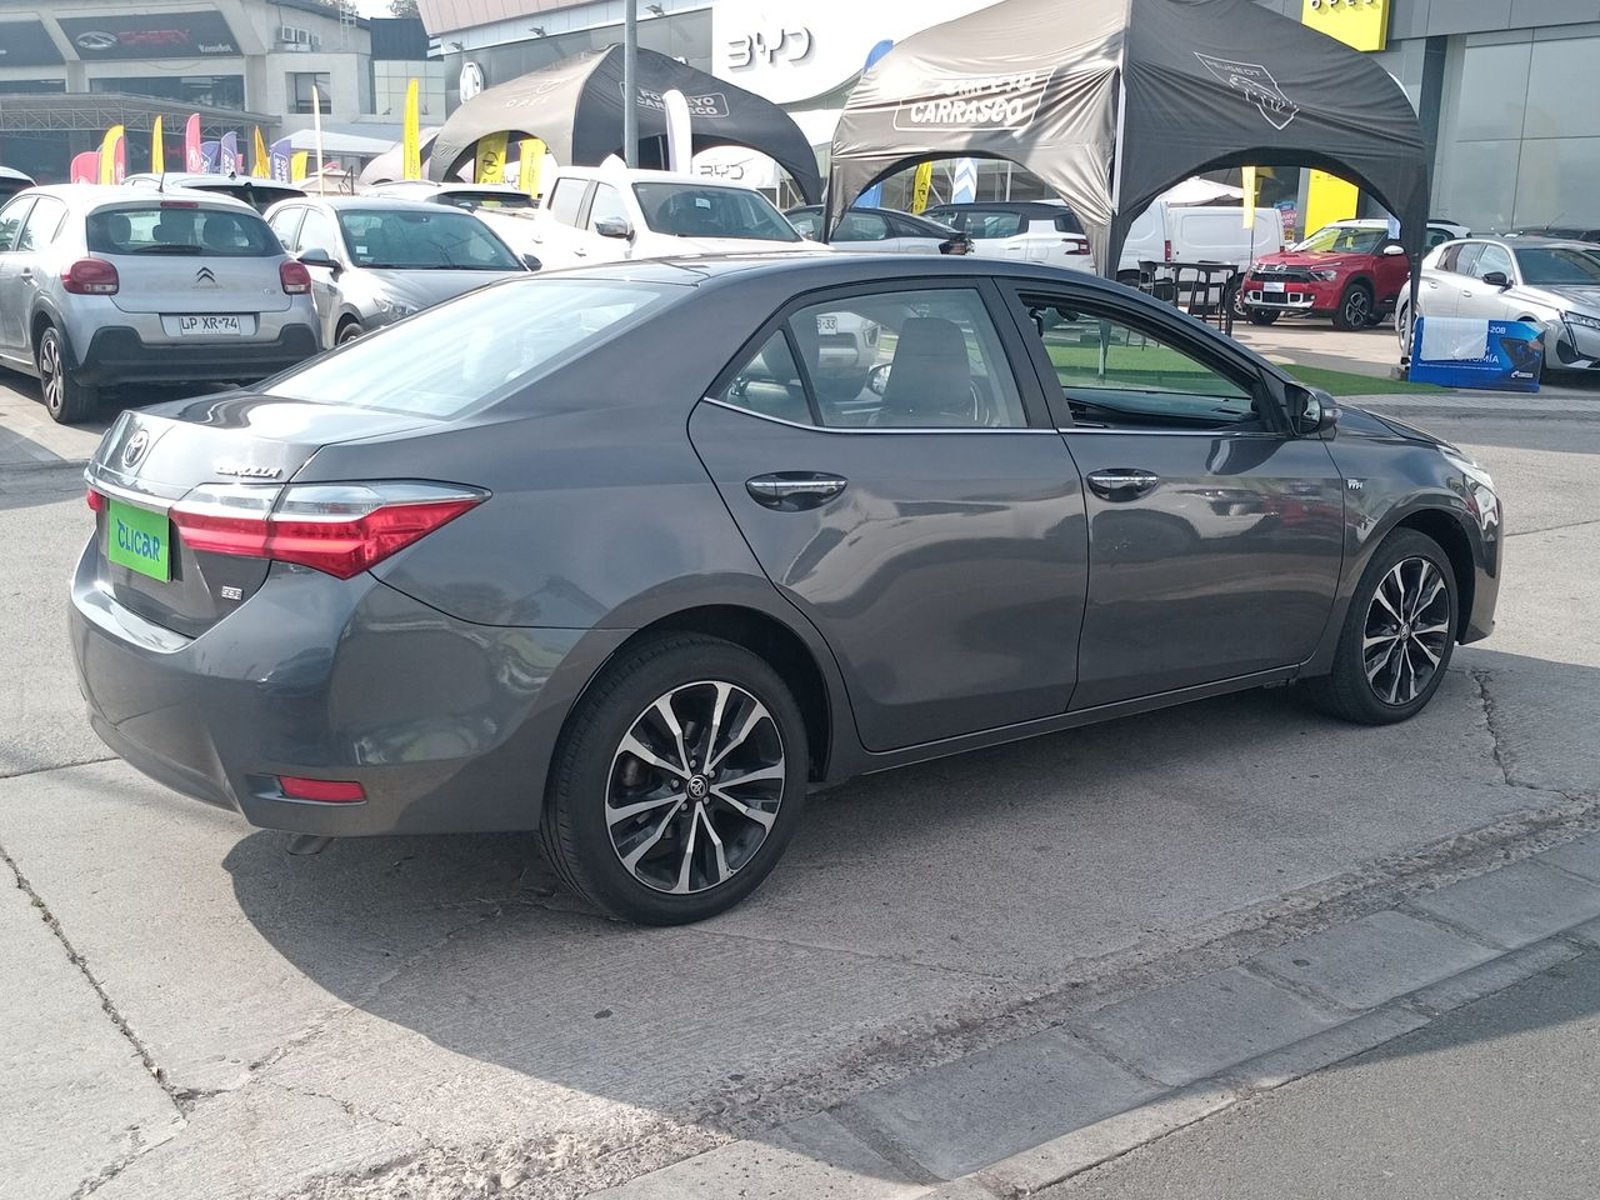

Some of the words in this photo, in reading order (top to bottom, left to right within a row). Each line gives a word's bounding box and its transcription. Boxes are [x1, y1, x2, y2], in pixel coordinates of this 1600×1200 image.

[727, 27, 812, 70] BYD
[910, 98, 1024, 124] CARRASCO
[180, 317, 198, 330] LP
